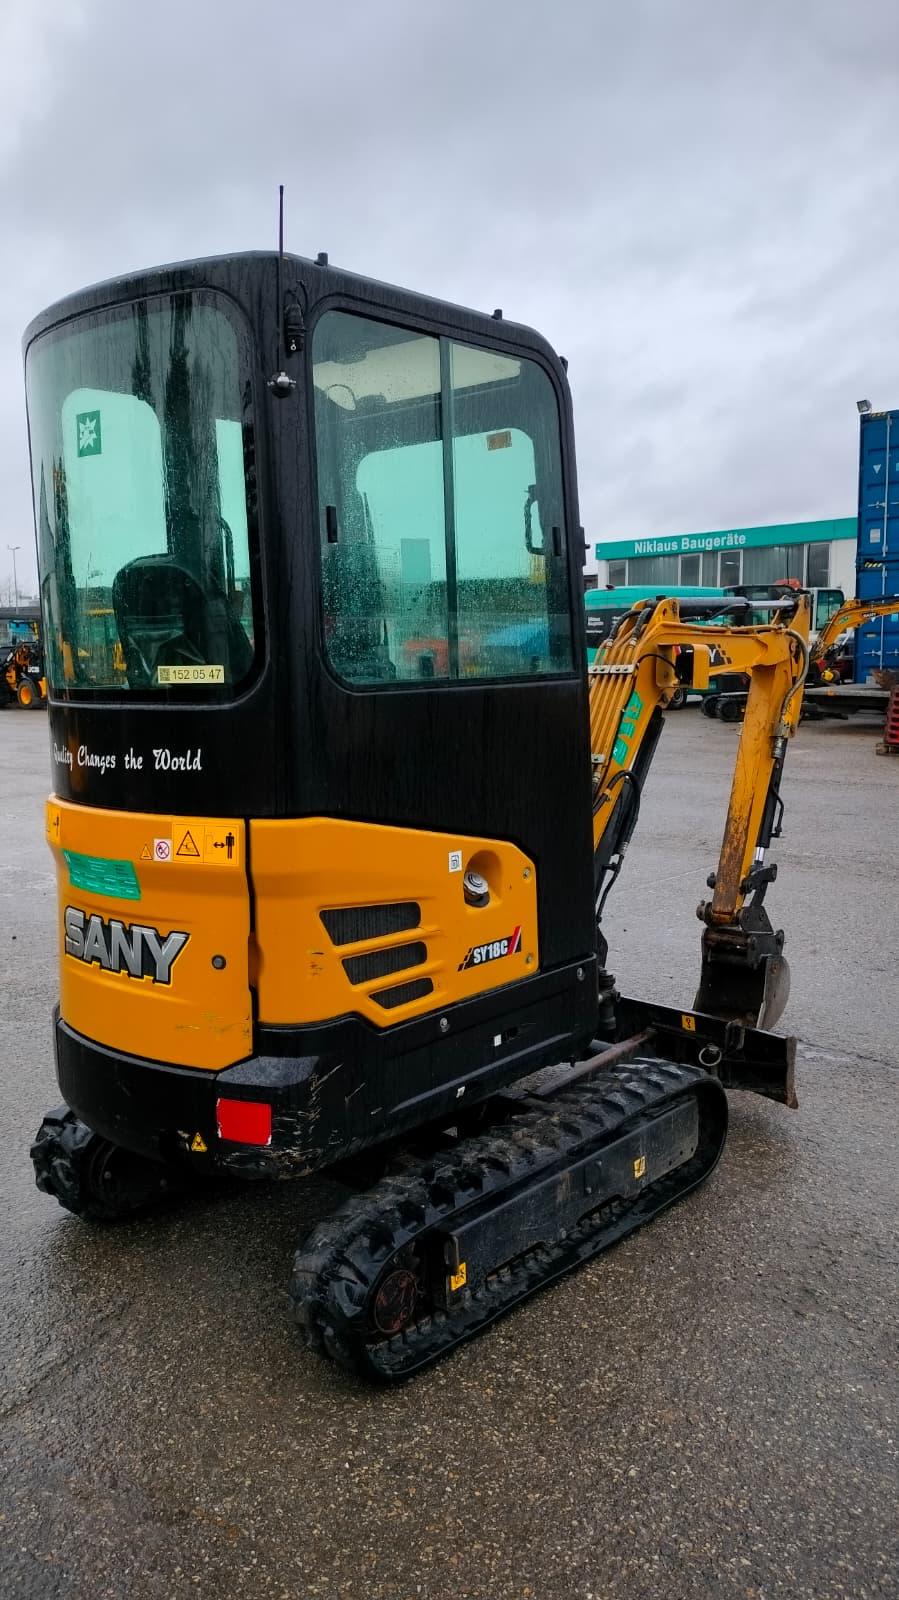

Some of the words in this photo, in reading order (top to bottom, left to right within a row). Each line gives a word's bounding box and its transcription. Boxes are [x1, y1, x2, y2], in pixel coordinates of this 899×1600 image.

[634, 540, 678, 554] Niklaus
[681, 533, 746, 550] Baugeräte
[172, 669, 190, 680] 152
[192, 669, 206, 680] 05
[208, 669, 222, 680] 47
[77, 745, 116, 775] Changes
[124, 747, 143, 770] the
[152, 748, 203, 771] World
[64, 905, 191, 986] SANY
[473, 939, 509, 964] SY18C
